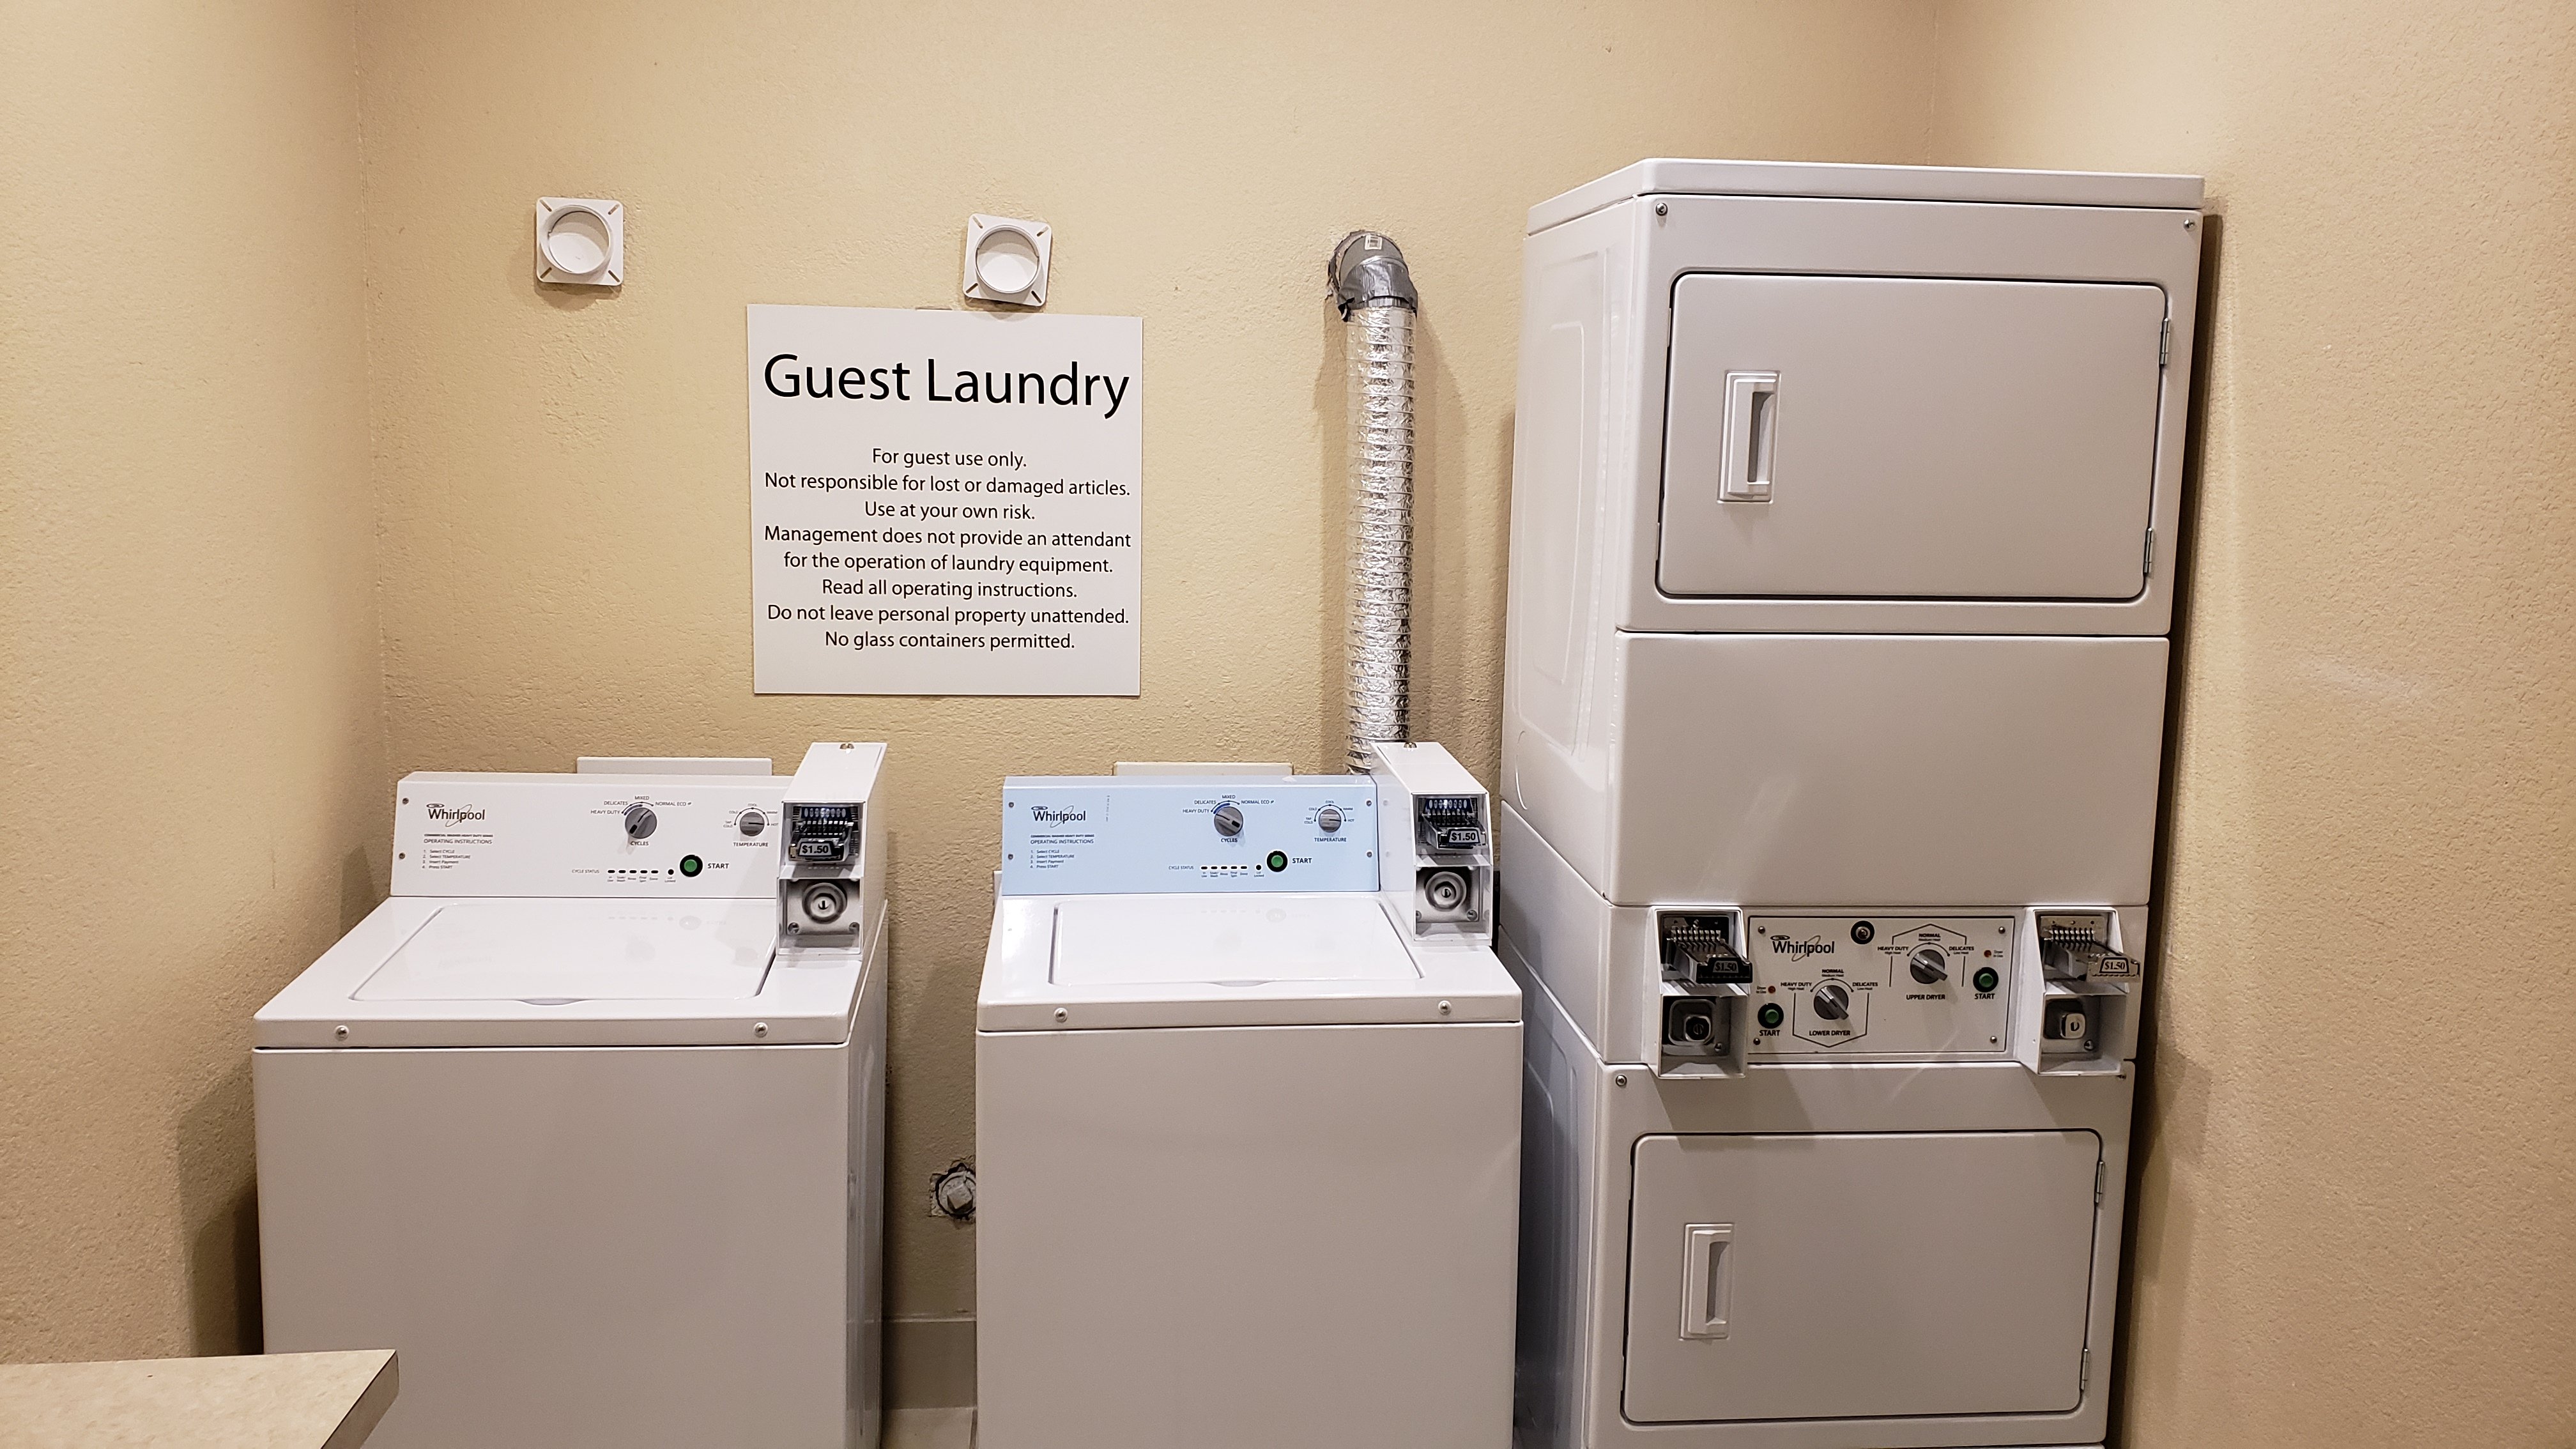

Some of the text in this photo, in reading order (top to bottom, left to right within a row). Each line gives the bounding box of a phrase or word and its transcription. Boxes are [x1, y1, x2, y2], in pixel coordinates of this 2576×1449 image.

[764, 353, 1130, 420] Guest Laundry
[873, 448, 1027, 471] For guest use only.
[765, 472, 1130, 498] Not responsible for lost or damaged articles.
[865, 501, 1035, 521] Use at your own risk.
[765, 525, 1131, 548] Management does not provide an attendant
[783, 551, 1113, 576] for the operation of laundry equipment.
[822, 579, 1077, 601] Read all operating instructions.
[768, 604, 1129, 627] Do not leave personal property unattended.
[825, 631, 1075, 652] No glass containers permitted.
[428, 809, 485, 823] Whirlpool
[1033, 811, 1086, 824] Whirlpool
[1452, 832, 1476, 841] $1.50
[802, 845, 829, 854] $1.50
[1772, 941, 1835, 957] Whirlpool
[1715, 962, 1736, 971] $1.50
